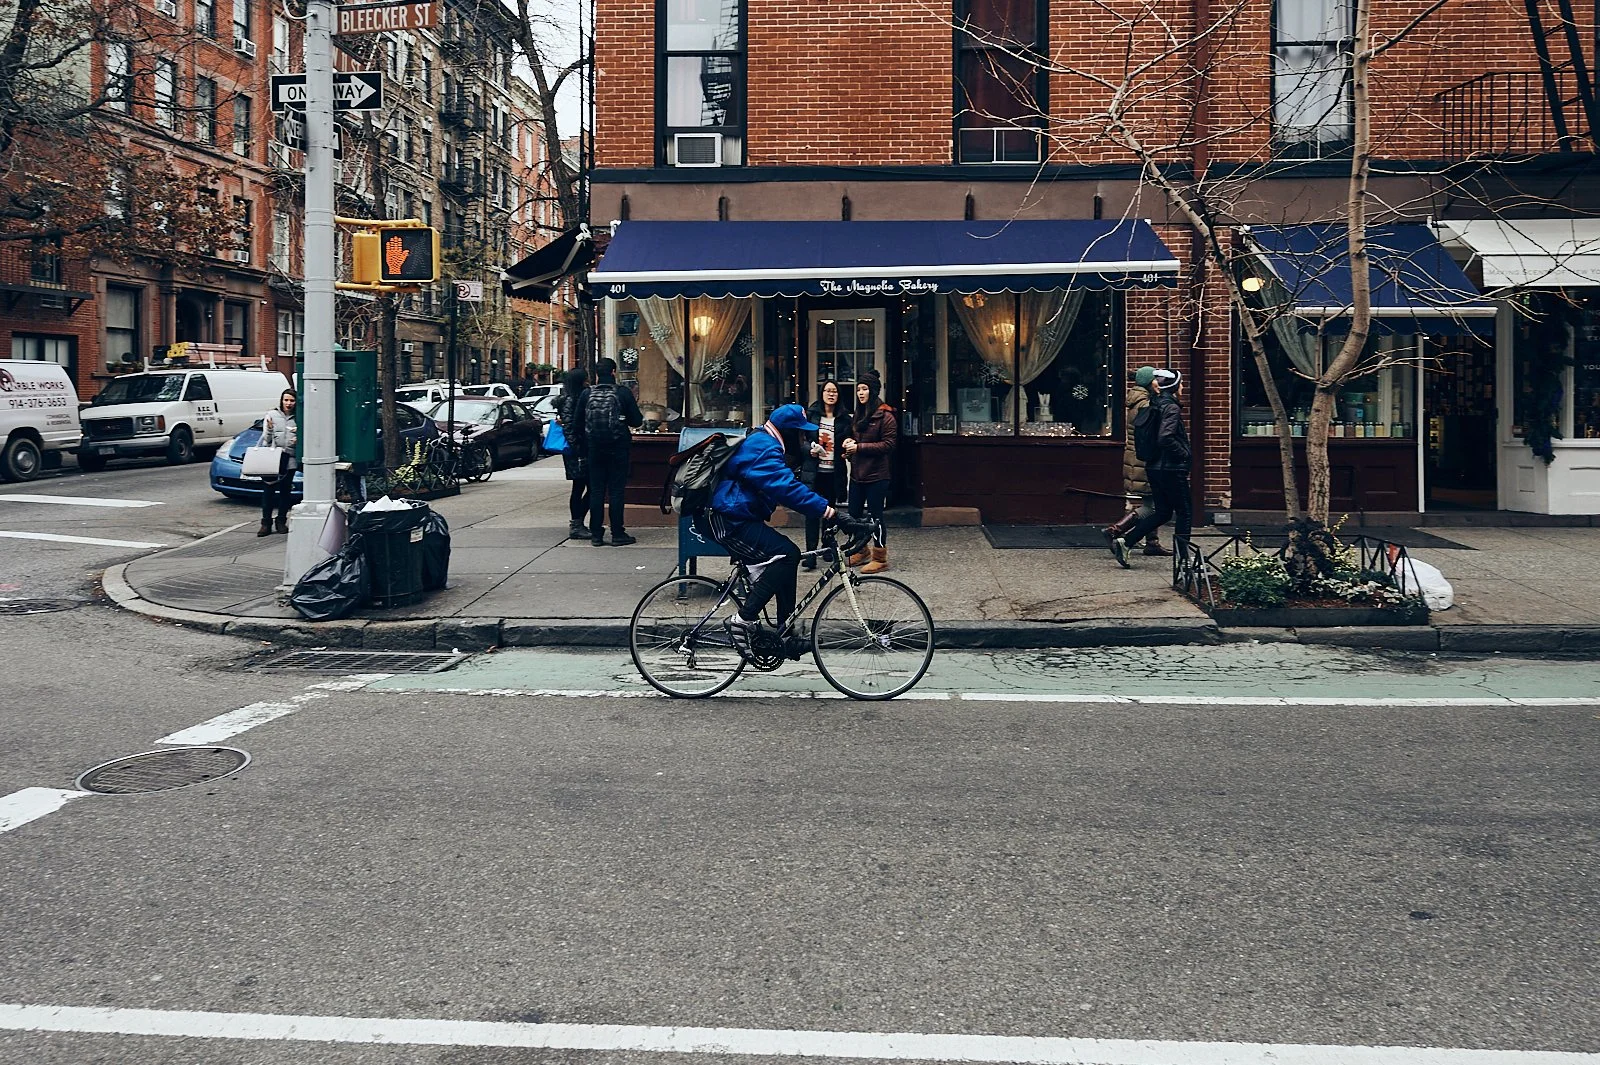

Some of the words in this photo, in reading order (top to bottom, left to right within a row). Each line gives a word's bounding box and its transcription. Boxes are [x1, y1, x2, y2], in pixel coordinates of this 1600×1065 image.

[341, 6, 408, 32] BLEECKER
[414, 3, 431, 26] ST
[288, 86, 307, 100] ON
[333, 84, 365, 99] WAY
[609, 283, 626, 294] 401
[819, 280, 843, 292] The
[846, 279, 895, 294] Magnolia
[898, 278, 939, 293] Bakery
[38, 381, 65, 390] WORKS
[9, 397, 67, 409] 914-376-3653
